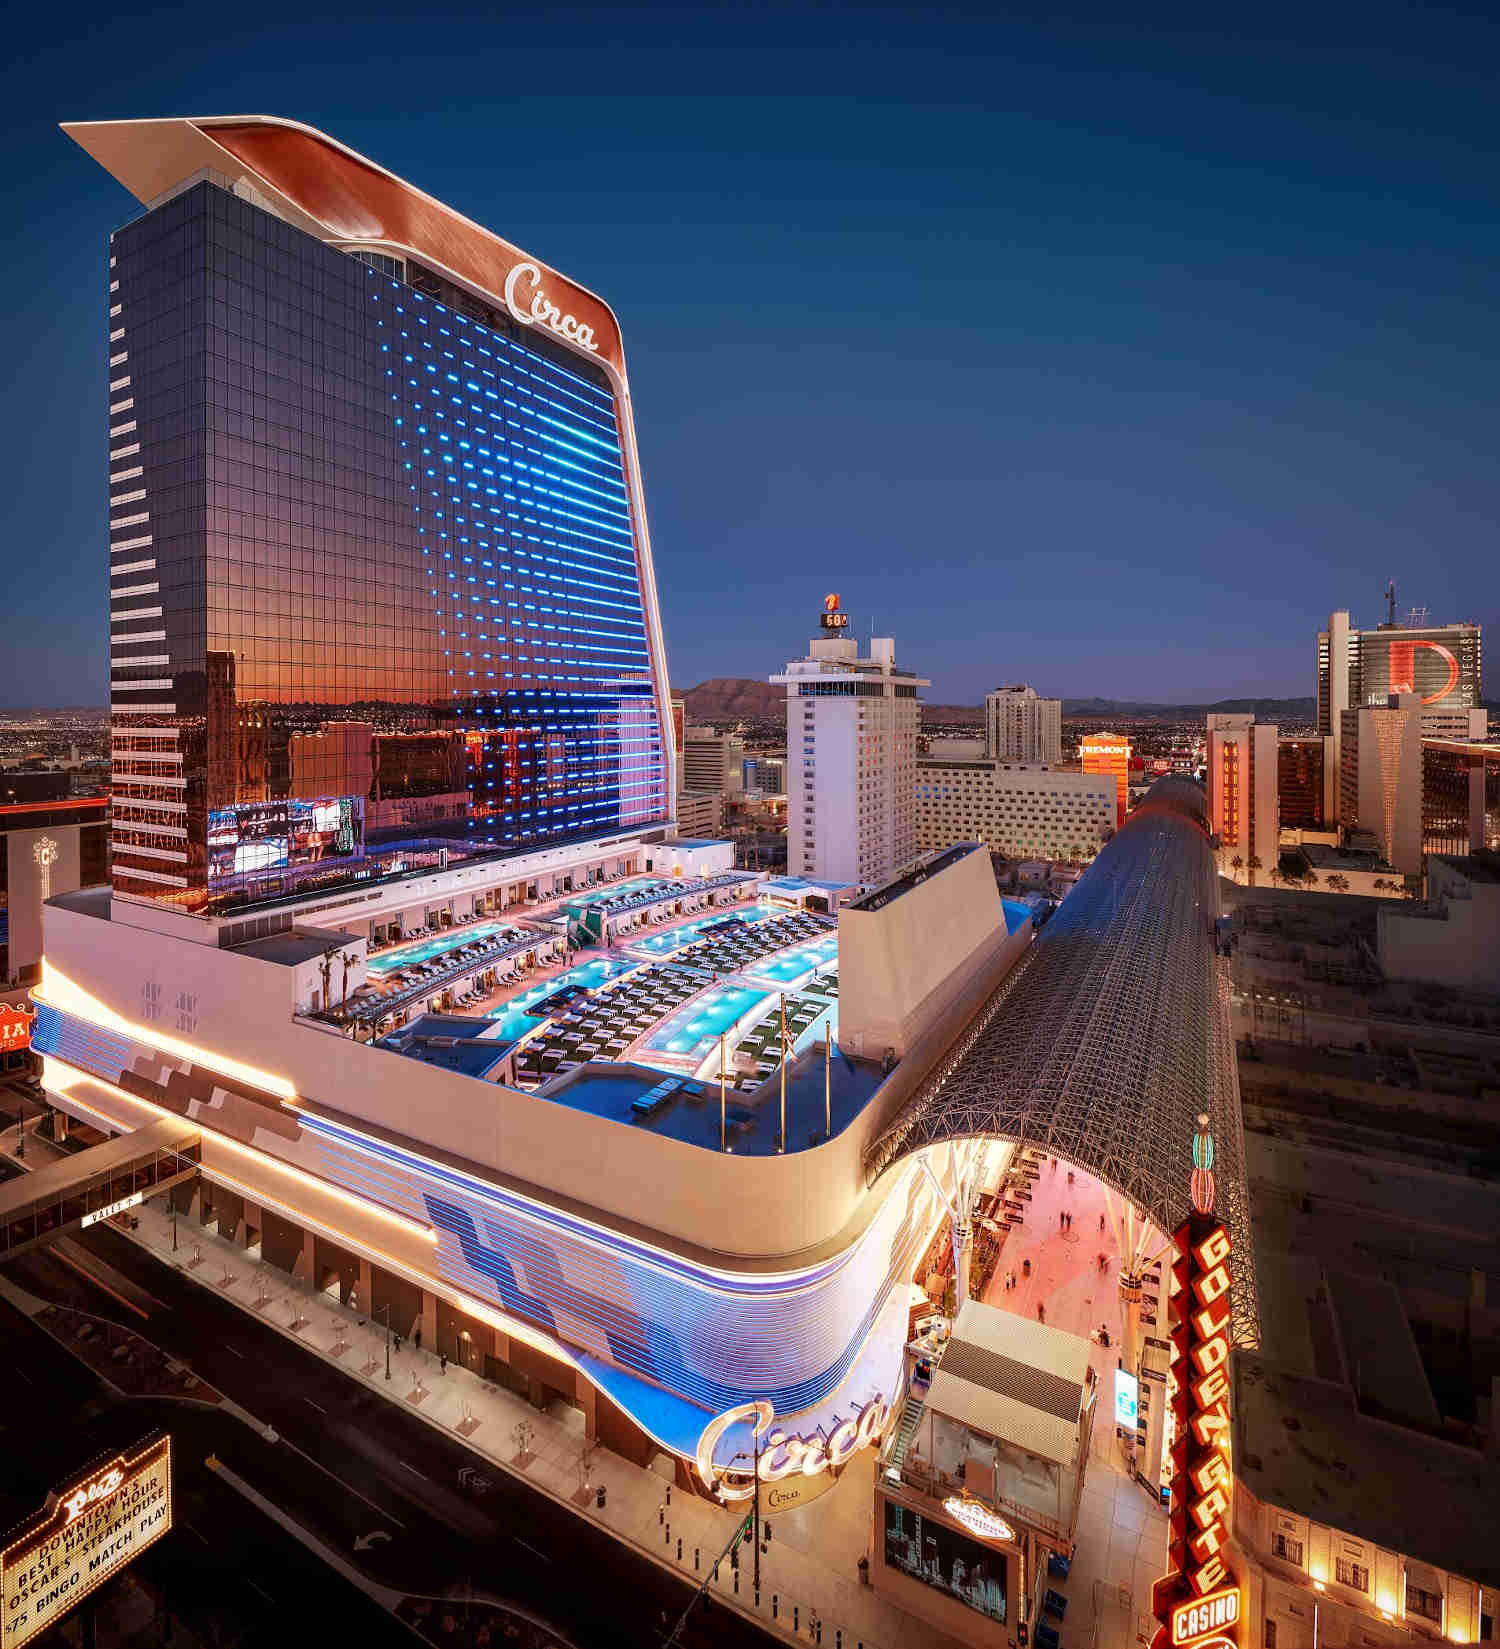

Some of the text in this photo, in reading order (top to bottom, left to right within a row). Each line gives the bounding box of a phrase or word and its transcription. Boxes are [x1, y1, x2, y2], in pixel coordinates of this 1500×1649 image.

[504, 262, 598, 350] Circa
[1462, 638, 1473, 706] LAS VEGAS
[697, 1393, 888, 1500] Circa
[1195, 1229, 1231, 1595] GOLDEN GATE
[18, 1553, 54, 1589] BEST
[65, 1511, 113, 1554] HAPPY
[122, 1478, 158, 1511] HOUR
[37, 1571, 80, 1613] BINGO
[89, 1530, 132, 1573] MATCH
[140, 1503, 167, 1532] PLAY
[82, 1486, 164, 1556] STEAKHOUSE
[1178, 1595, 1237, 1640] CASINO
